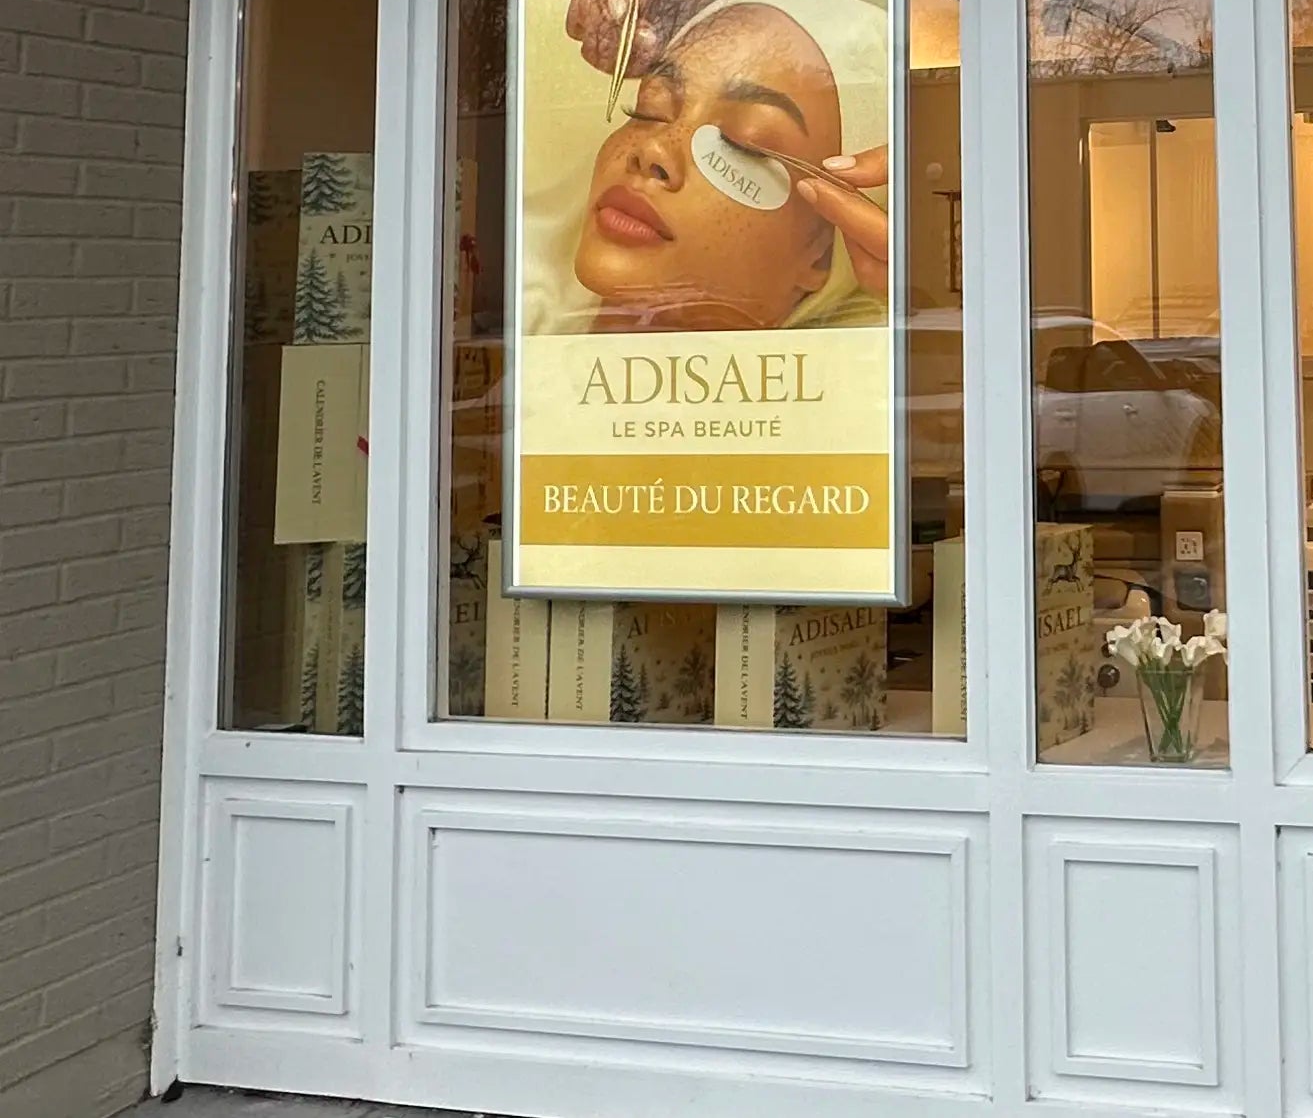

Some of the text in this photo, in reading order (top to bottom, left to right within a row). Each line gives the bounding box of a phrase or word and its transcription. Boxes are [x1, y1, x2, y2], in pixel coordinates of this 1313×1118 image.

[702, 151, 762, 204] ADISAEL
[579, 353, 825, 406] ADISAEL
[612, 415, 782, 438] LE SPA BEAUTÉ
[543, 478, 871, 515] BEAUTÉ DU REGARD
[789, 607, 878, 647] ADISAEL
[1039, 606, 1087, 639] ISAEL
